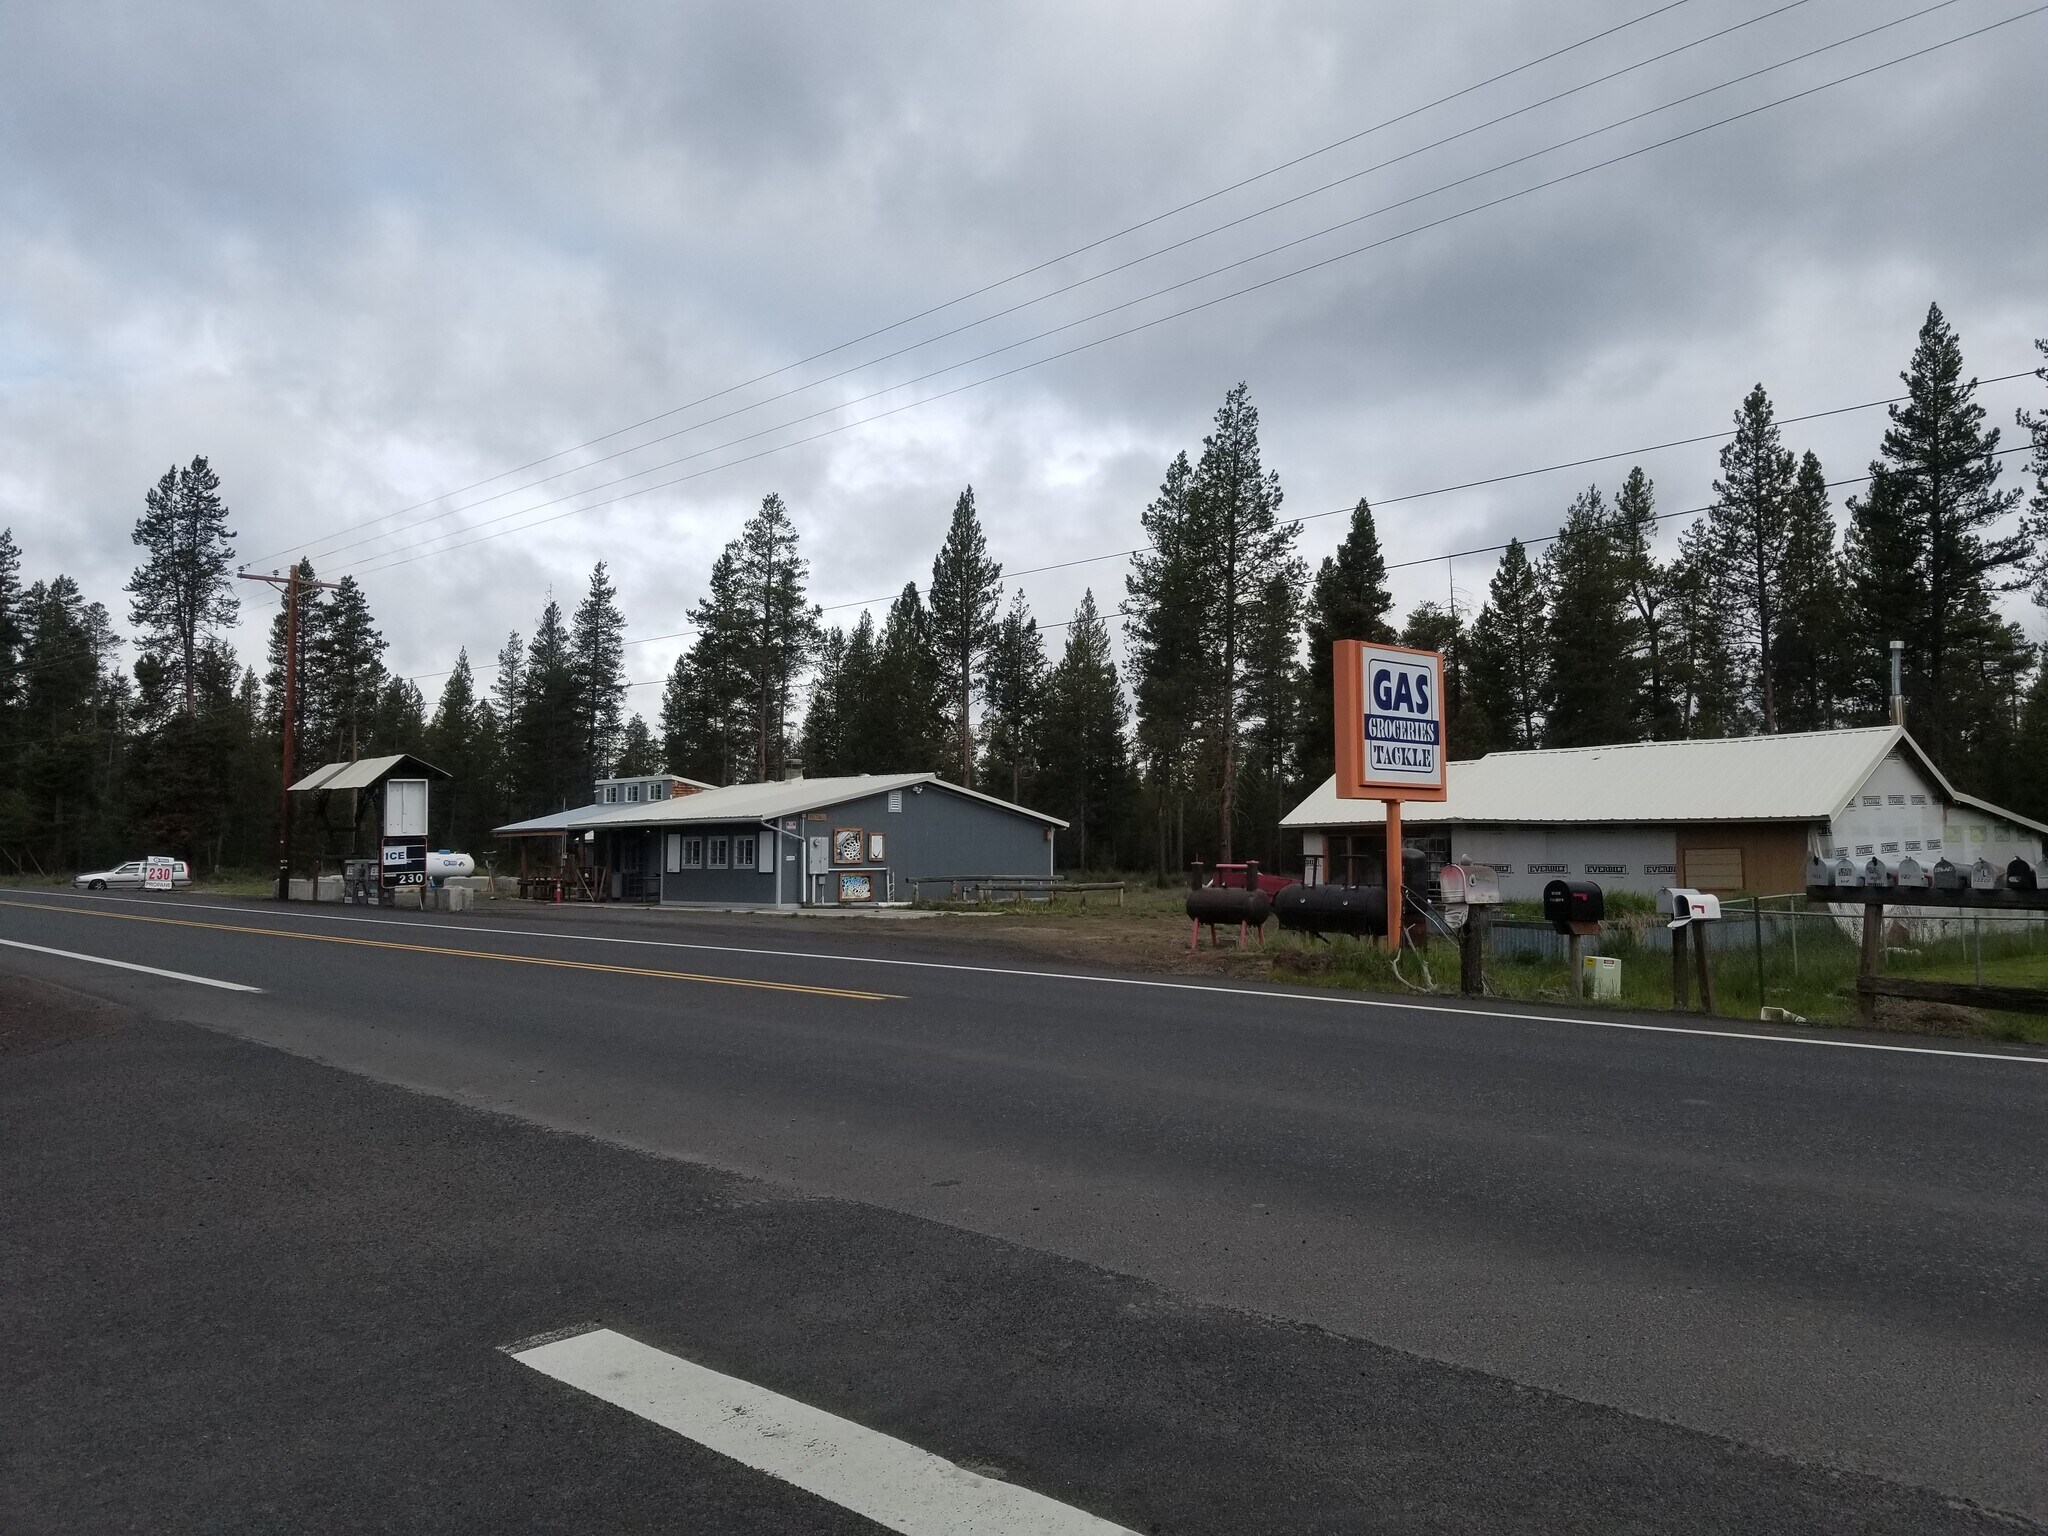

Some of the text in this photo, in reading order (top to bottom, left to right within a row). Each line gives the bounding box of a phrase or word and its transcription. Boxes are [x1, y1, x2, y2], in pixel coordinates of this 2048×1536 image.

[1373, 668, 1429, 714] GAS
[1368, 717, 1434, 743] GROCERIES
[1373, 745, 1431, 768] TACKLE
[385, 851, 405, 860] ICE
[149, 867, 170, 880] 230
[1529, 865, 1567, 873] EVERBILT
[1587, 865, 1624, 873] EVERBILT
[399, 873, 423, 884] 230
